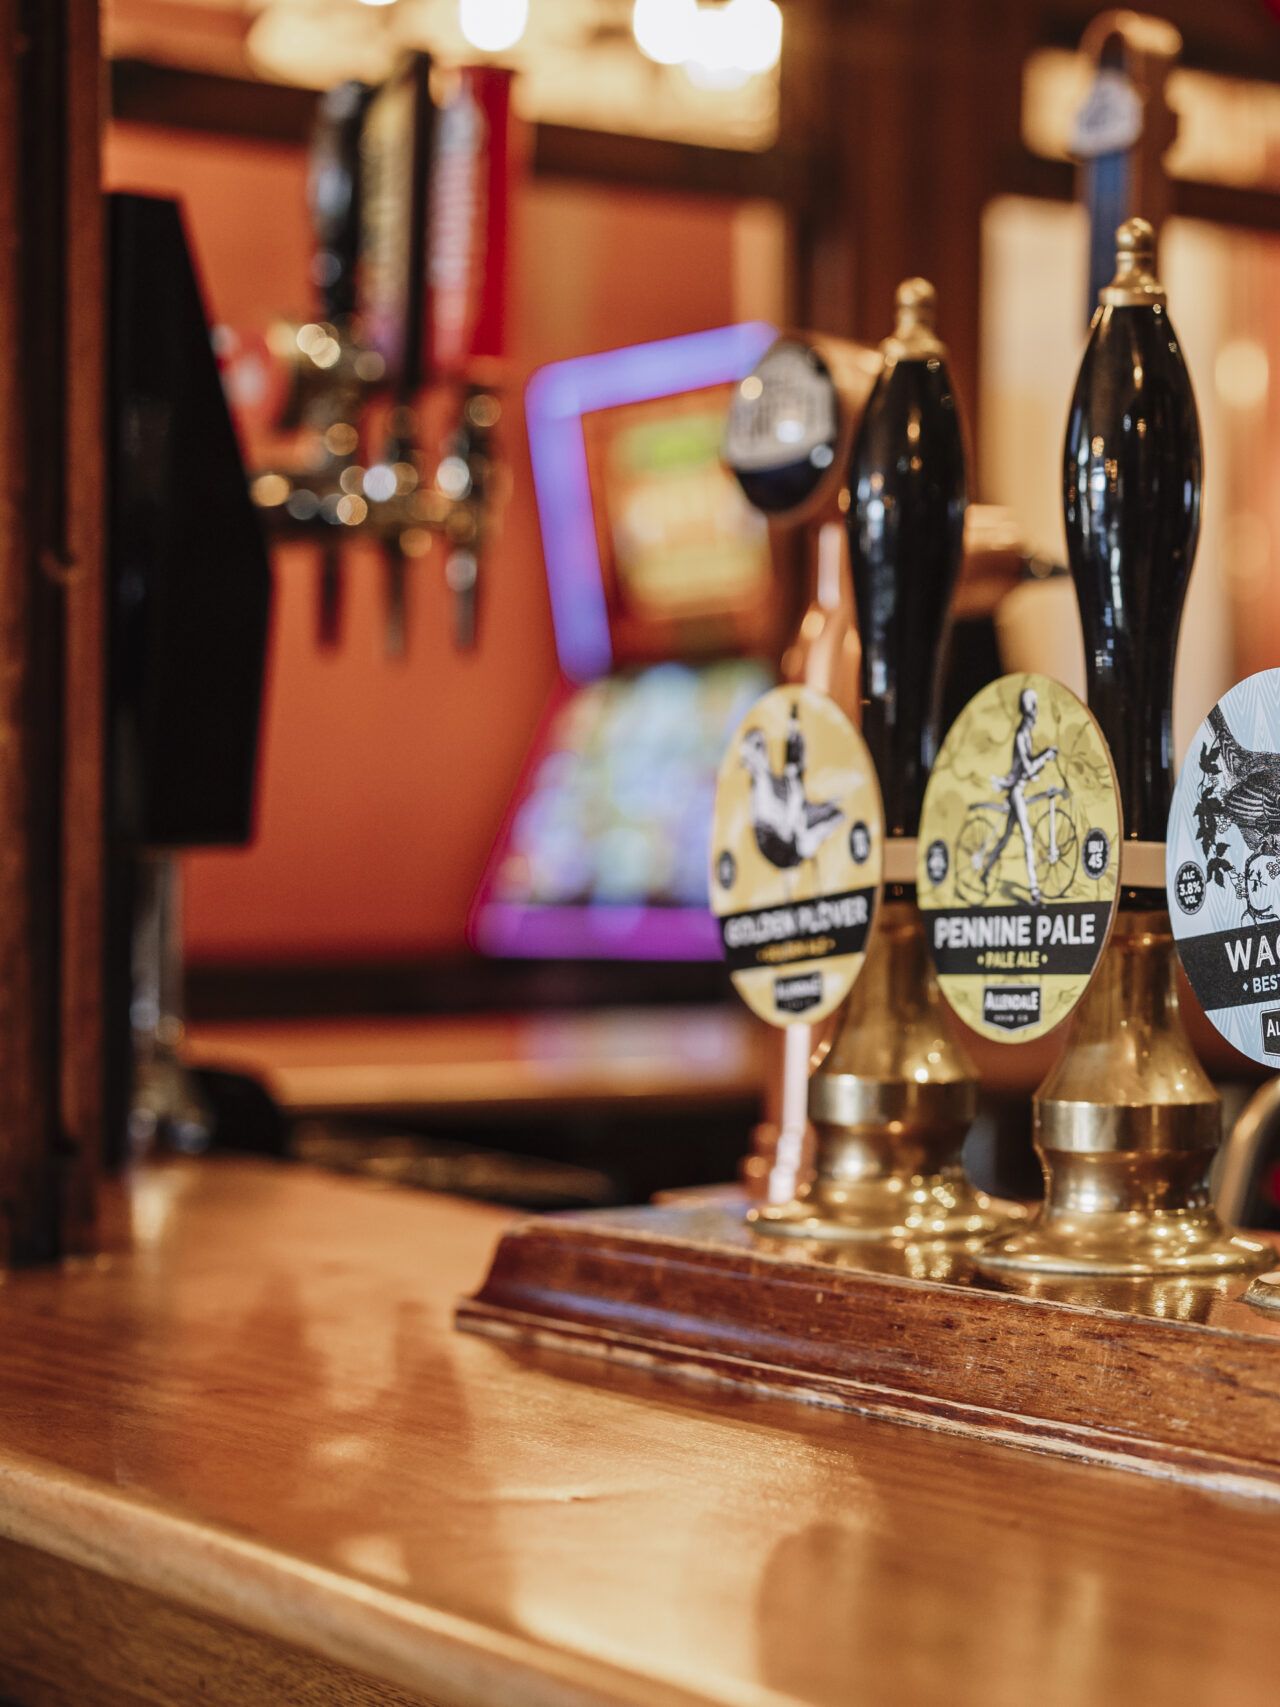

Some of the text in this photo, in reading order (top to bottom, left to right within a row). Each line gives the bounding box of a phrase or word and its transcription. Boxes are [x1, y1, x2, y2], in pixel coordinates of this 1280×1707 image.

[1088, 852, 1104, 869] 45
[1182, 870, 1196, 880] ALC
[1178, 880, 1202, 896] 3.8%
[1184, 895, 1199, 905] VOL
[934, 914, 1096, 949] PENNINE PALE
[985, 951, 1040, 968] PALE ALE
